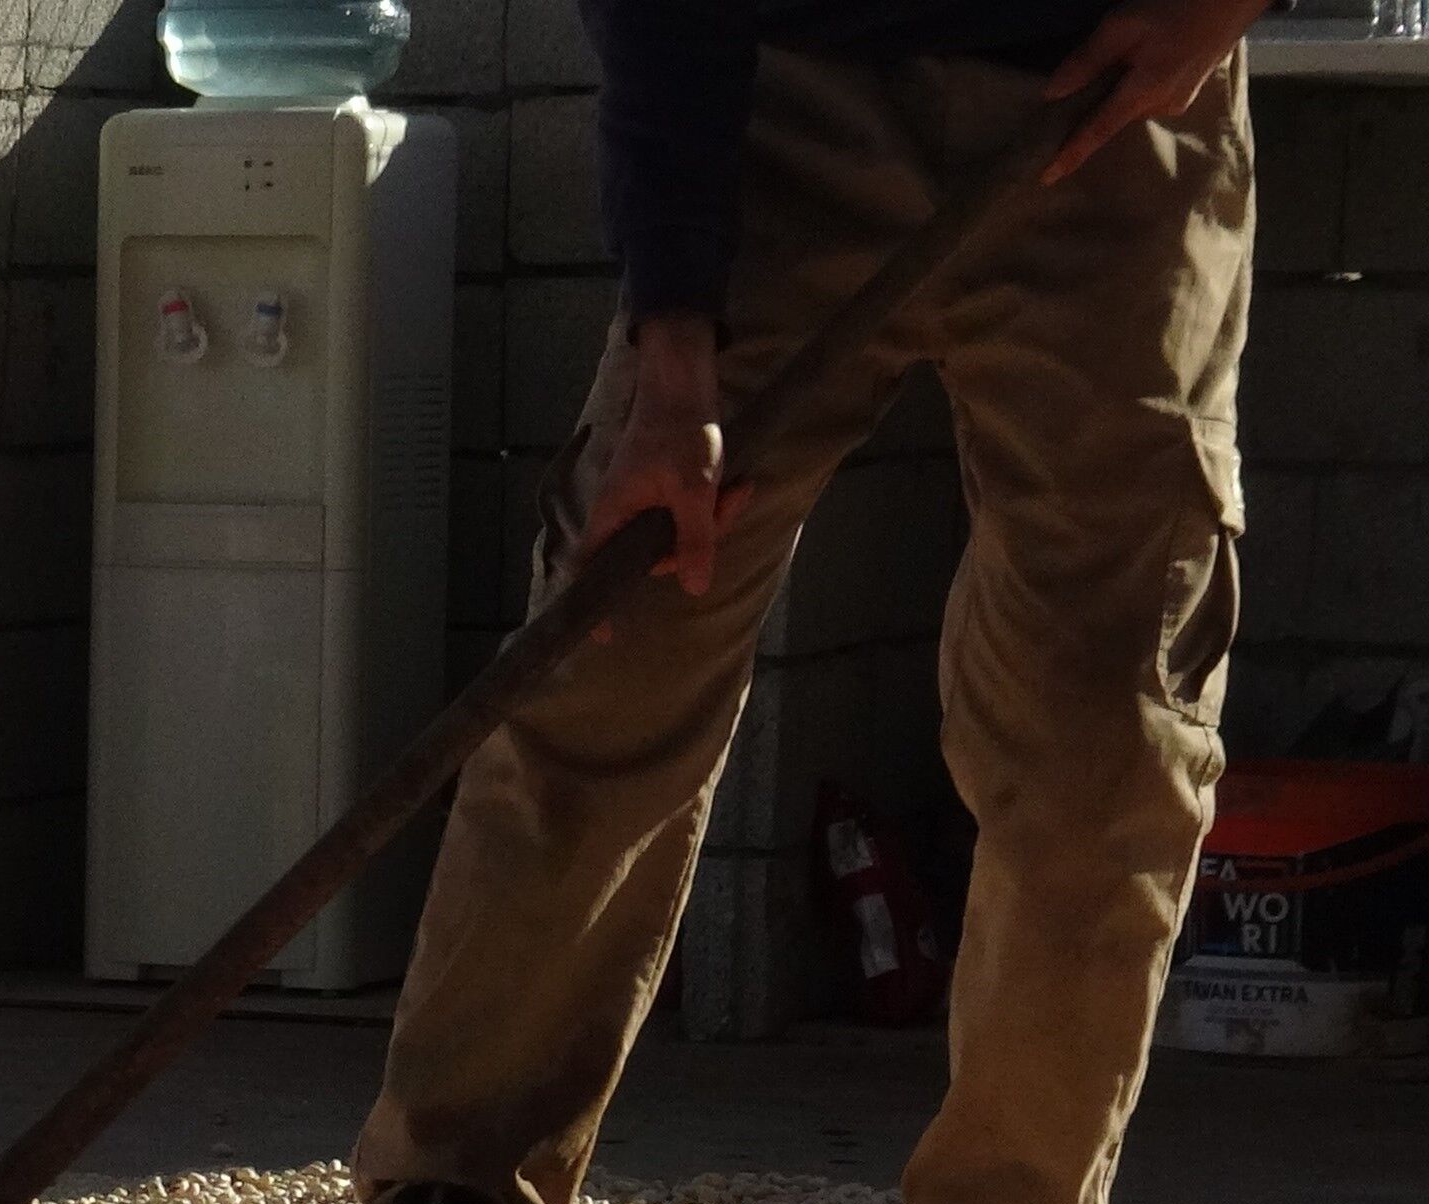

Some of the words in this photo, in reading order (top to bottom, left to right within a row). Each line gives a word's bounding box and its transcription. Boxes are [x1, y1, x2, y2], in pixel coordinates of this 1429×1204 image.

[1224, 891, 1289, 924] WO
[1241, 922, 1278, 954] RI
[1241, 984, 1310, 1004] EXTRA
